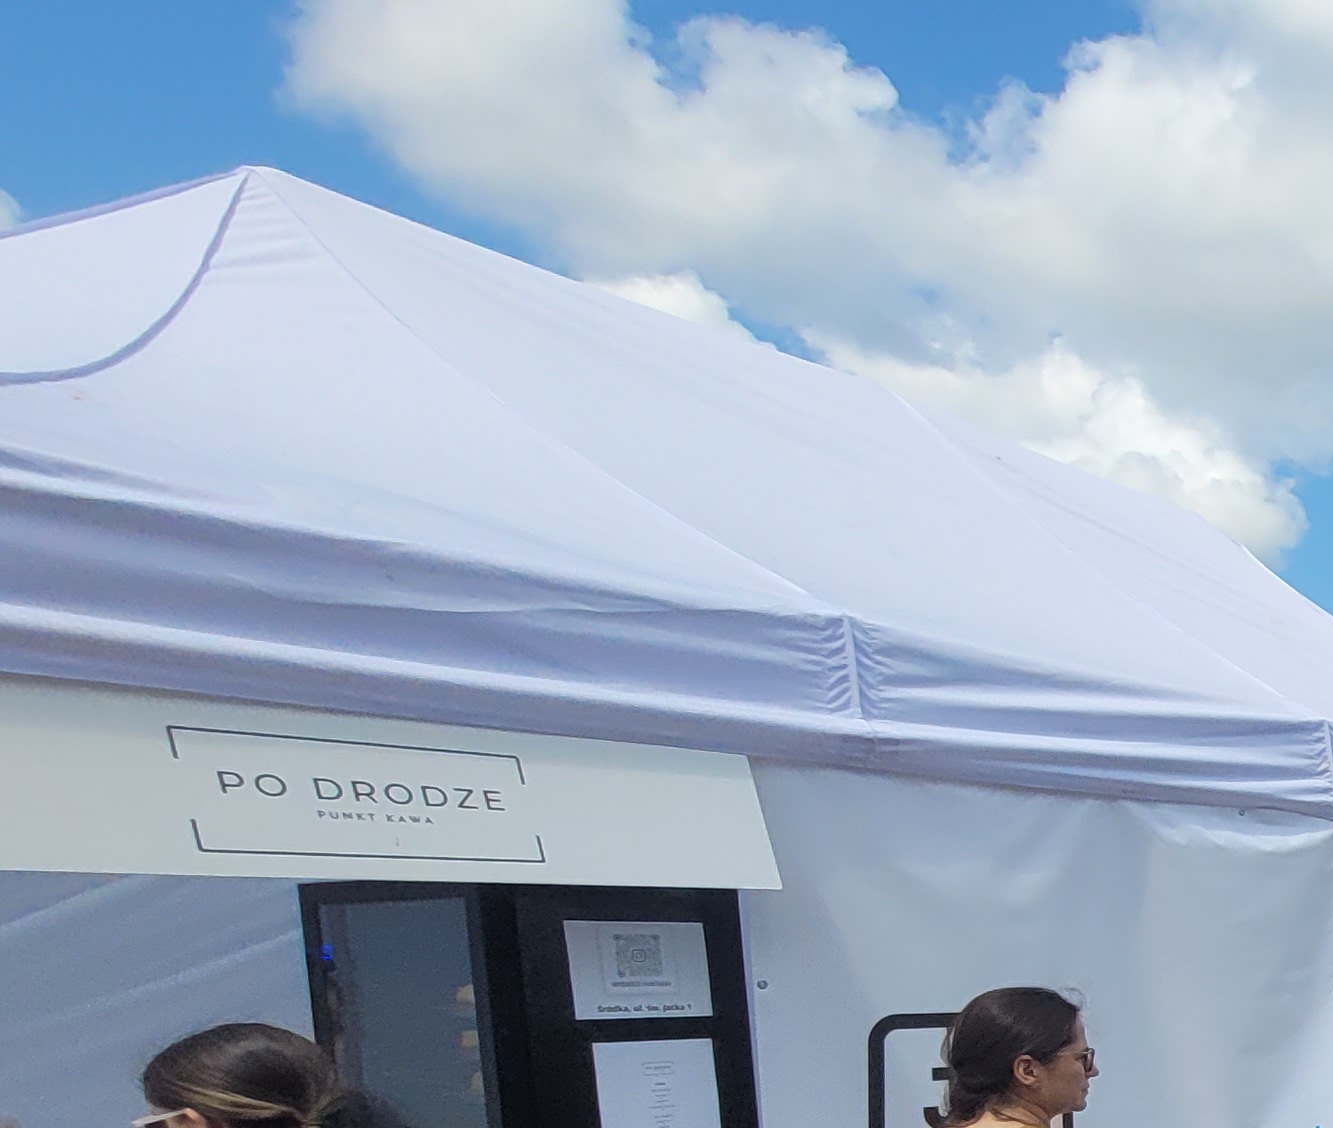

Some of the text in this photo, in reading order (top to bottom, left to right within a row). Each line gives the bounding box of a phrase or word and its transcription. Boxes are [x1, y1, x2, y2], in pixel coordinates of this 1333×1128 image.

[217, 770, 506, 812] PO DRODZE
[317, 810, 435, 825] PUNKT KAWA
